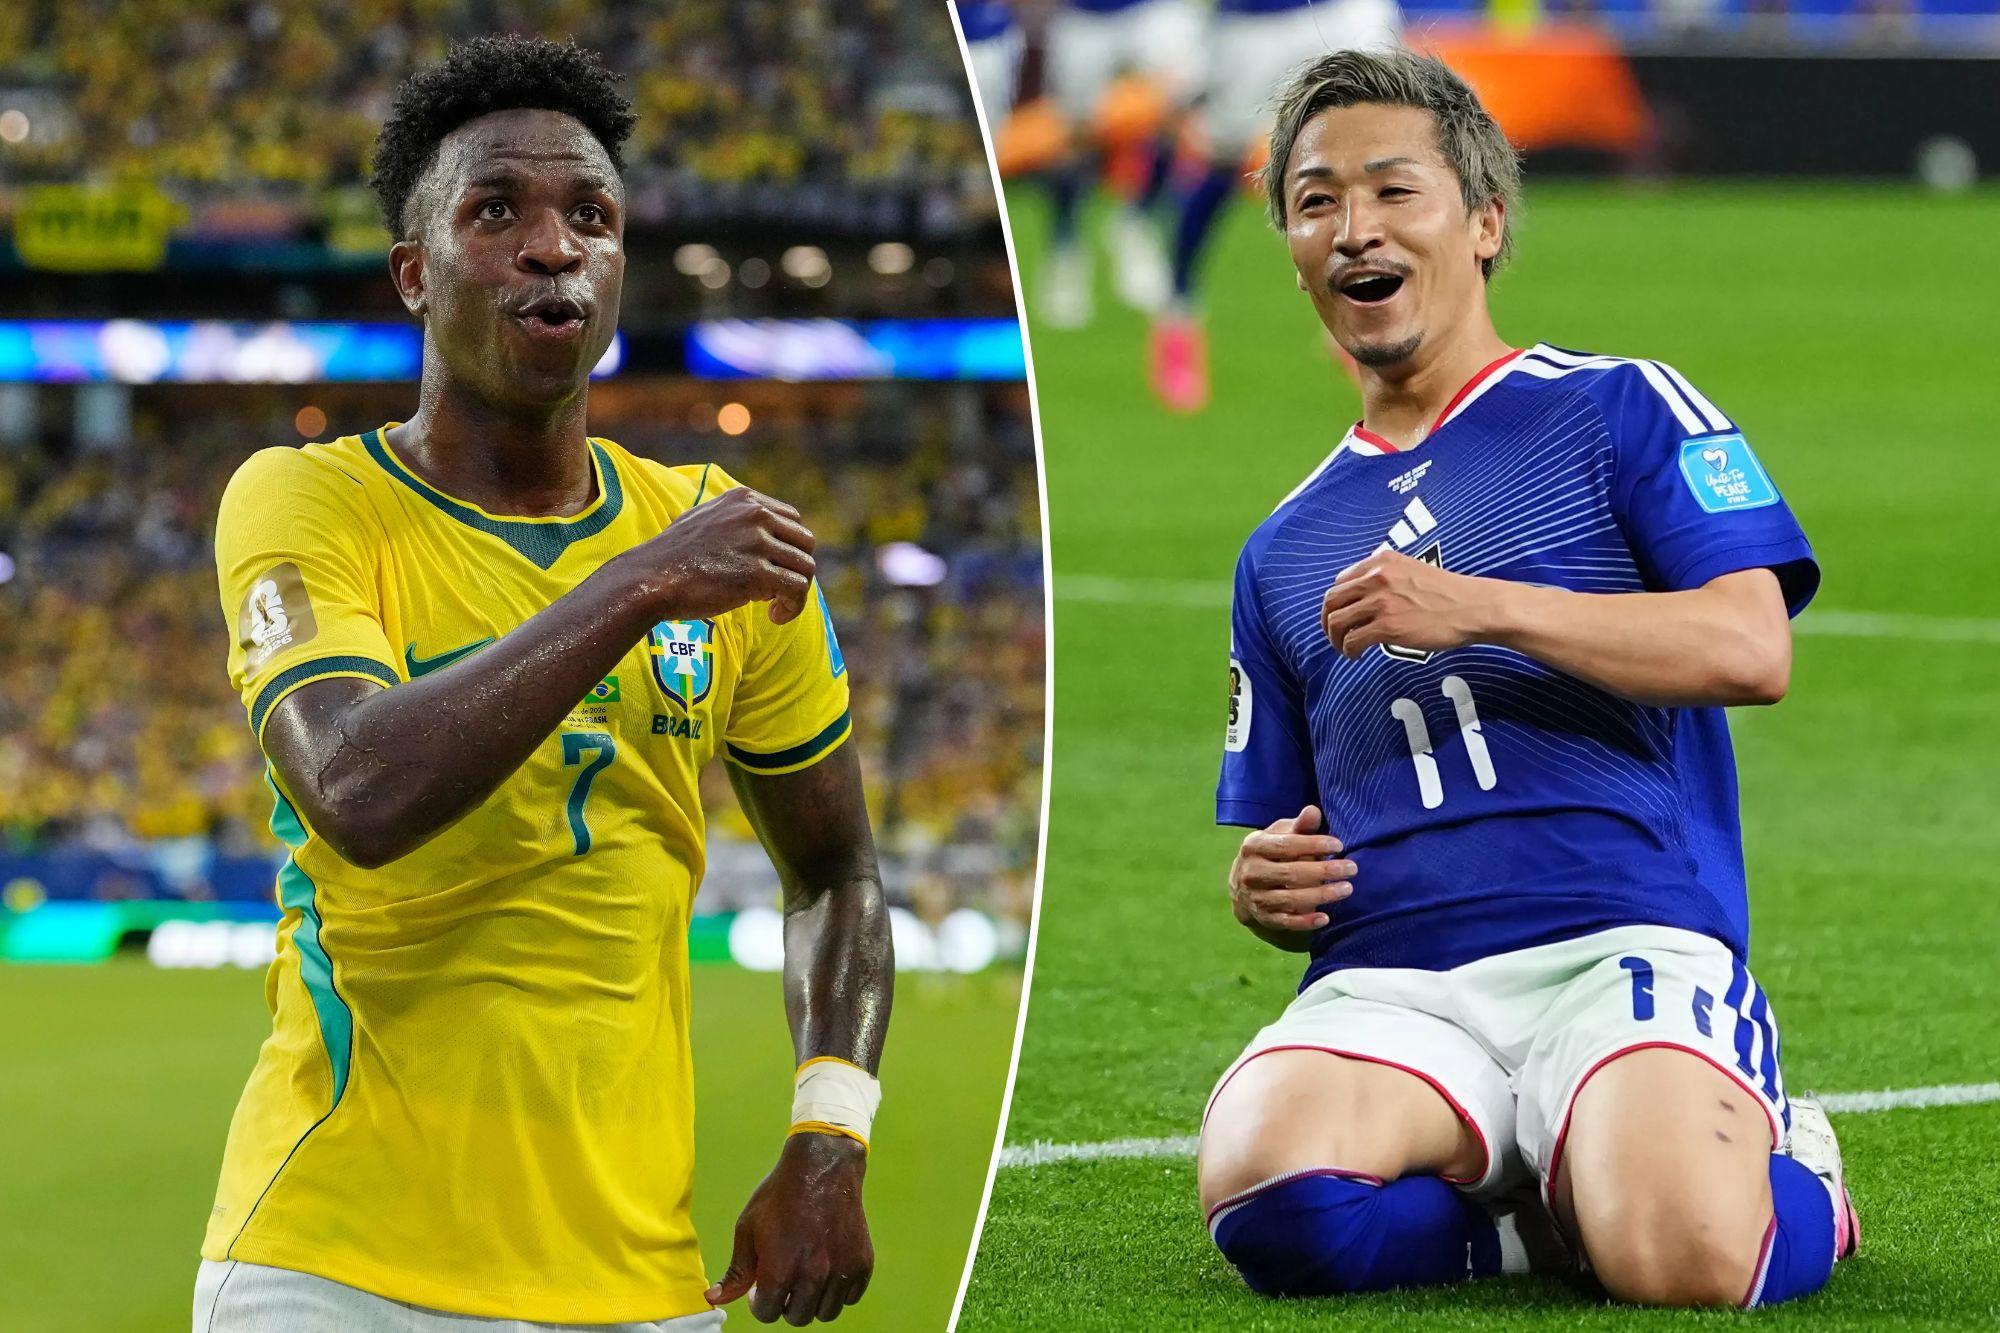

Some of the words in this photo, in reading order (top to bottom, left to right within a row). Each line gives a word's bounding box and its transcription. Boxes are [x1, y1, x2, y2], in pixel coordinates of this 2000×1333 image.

[669, 642, 696, 657] CBF
[590, 706, 607, 714] 2026
[1391, 675, 1497, 809] 11
[561, 732, 617, 857] 7
